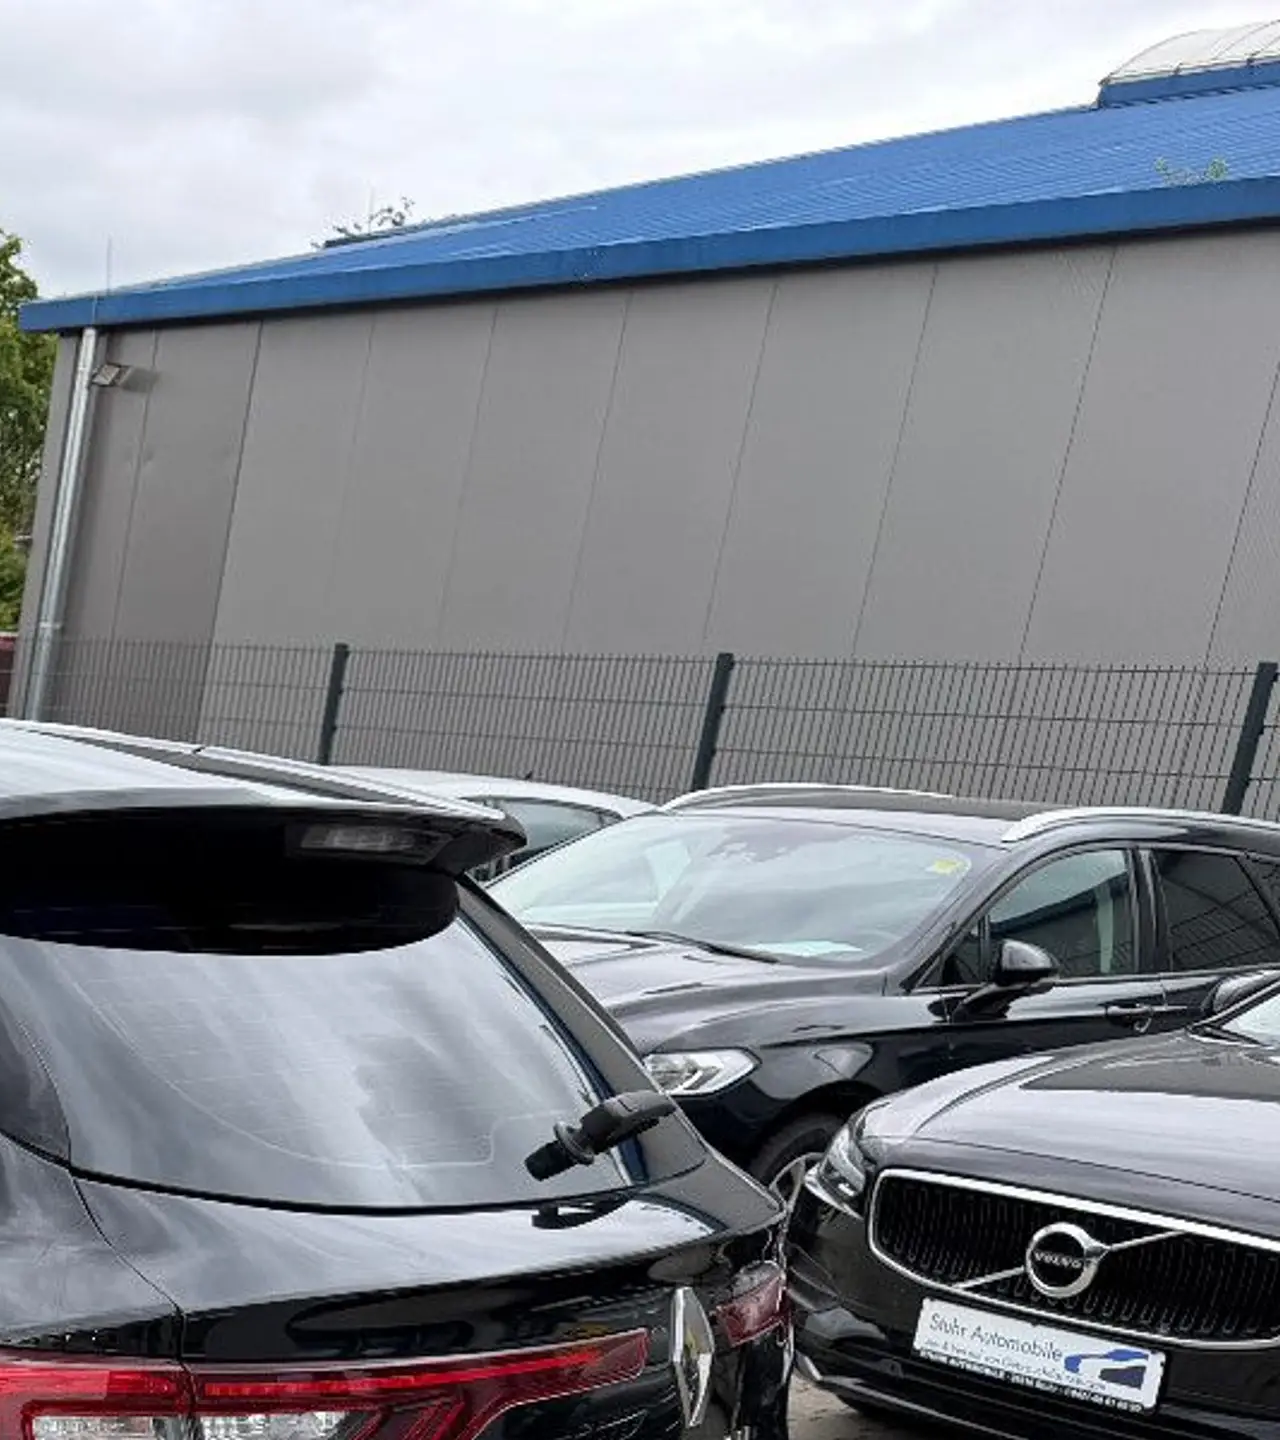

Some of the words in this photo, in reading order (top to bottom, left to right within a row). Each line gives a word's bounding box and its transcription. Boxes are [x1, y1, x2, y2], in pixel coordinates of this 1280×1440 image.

[1034, 1251, 1082, 1269] VOLVO
[929, 1312, 966, 1337] Stuhr
[971, 1325, 1063, 1362] Automobile
